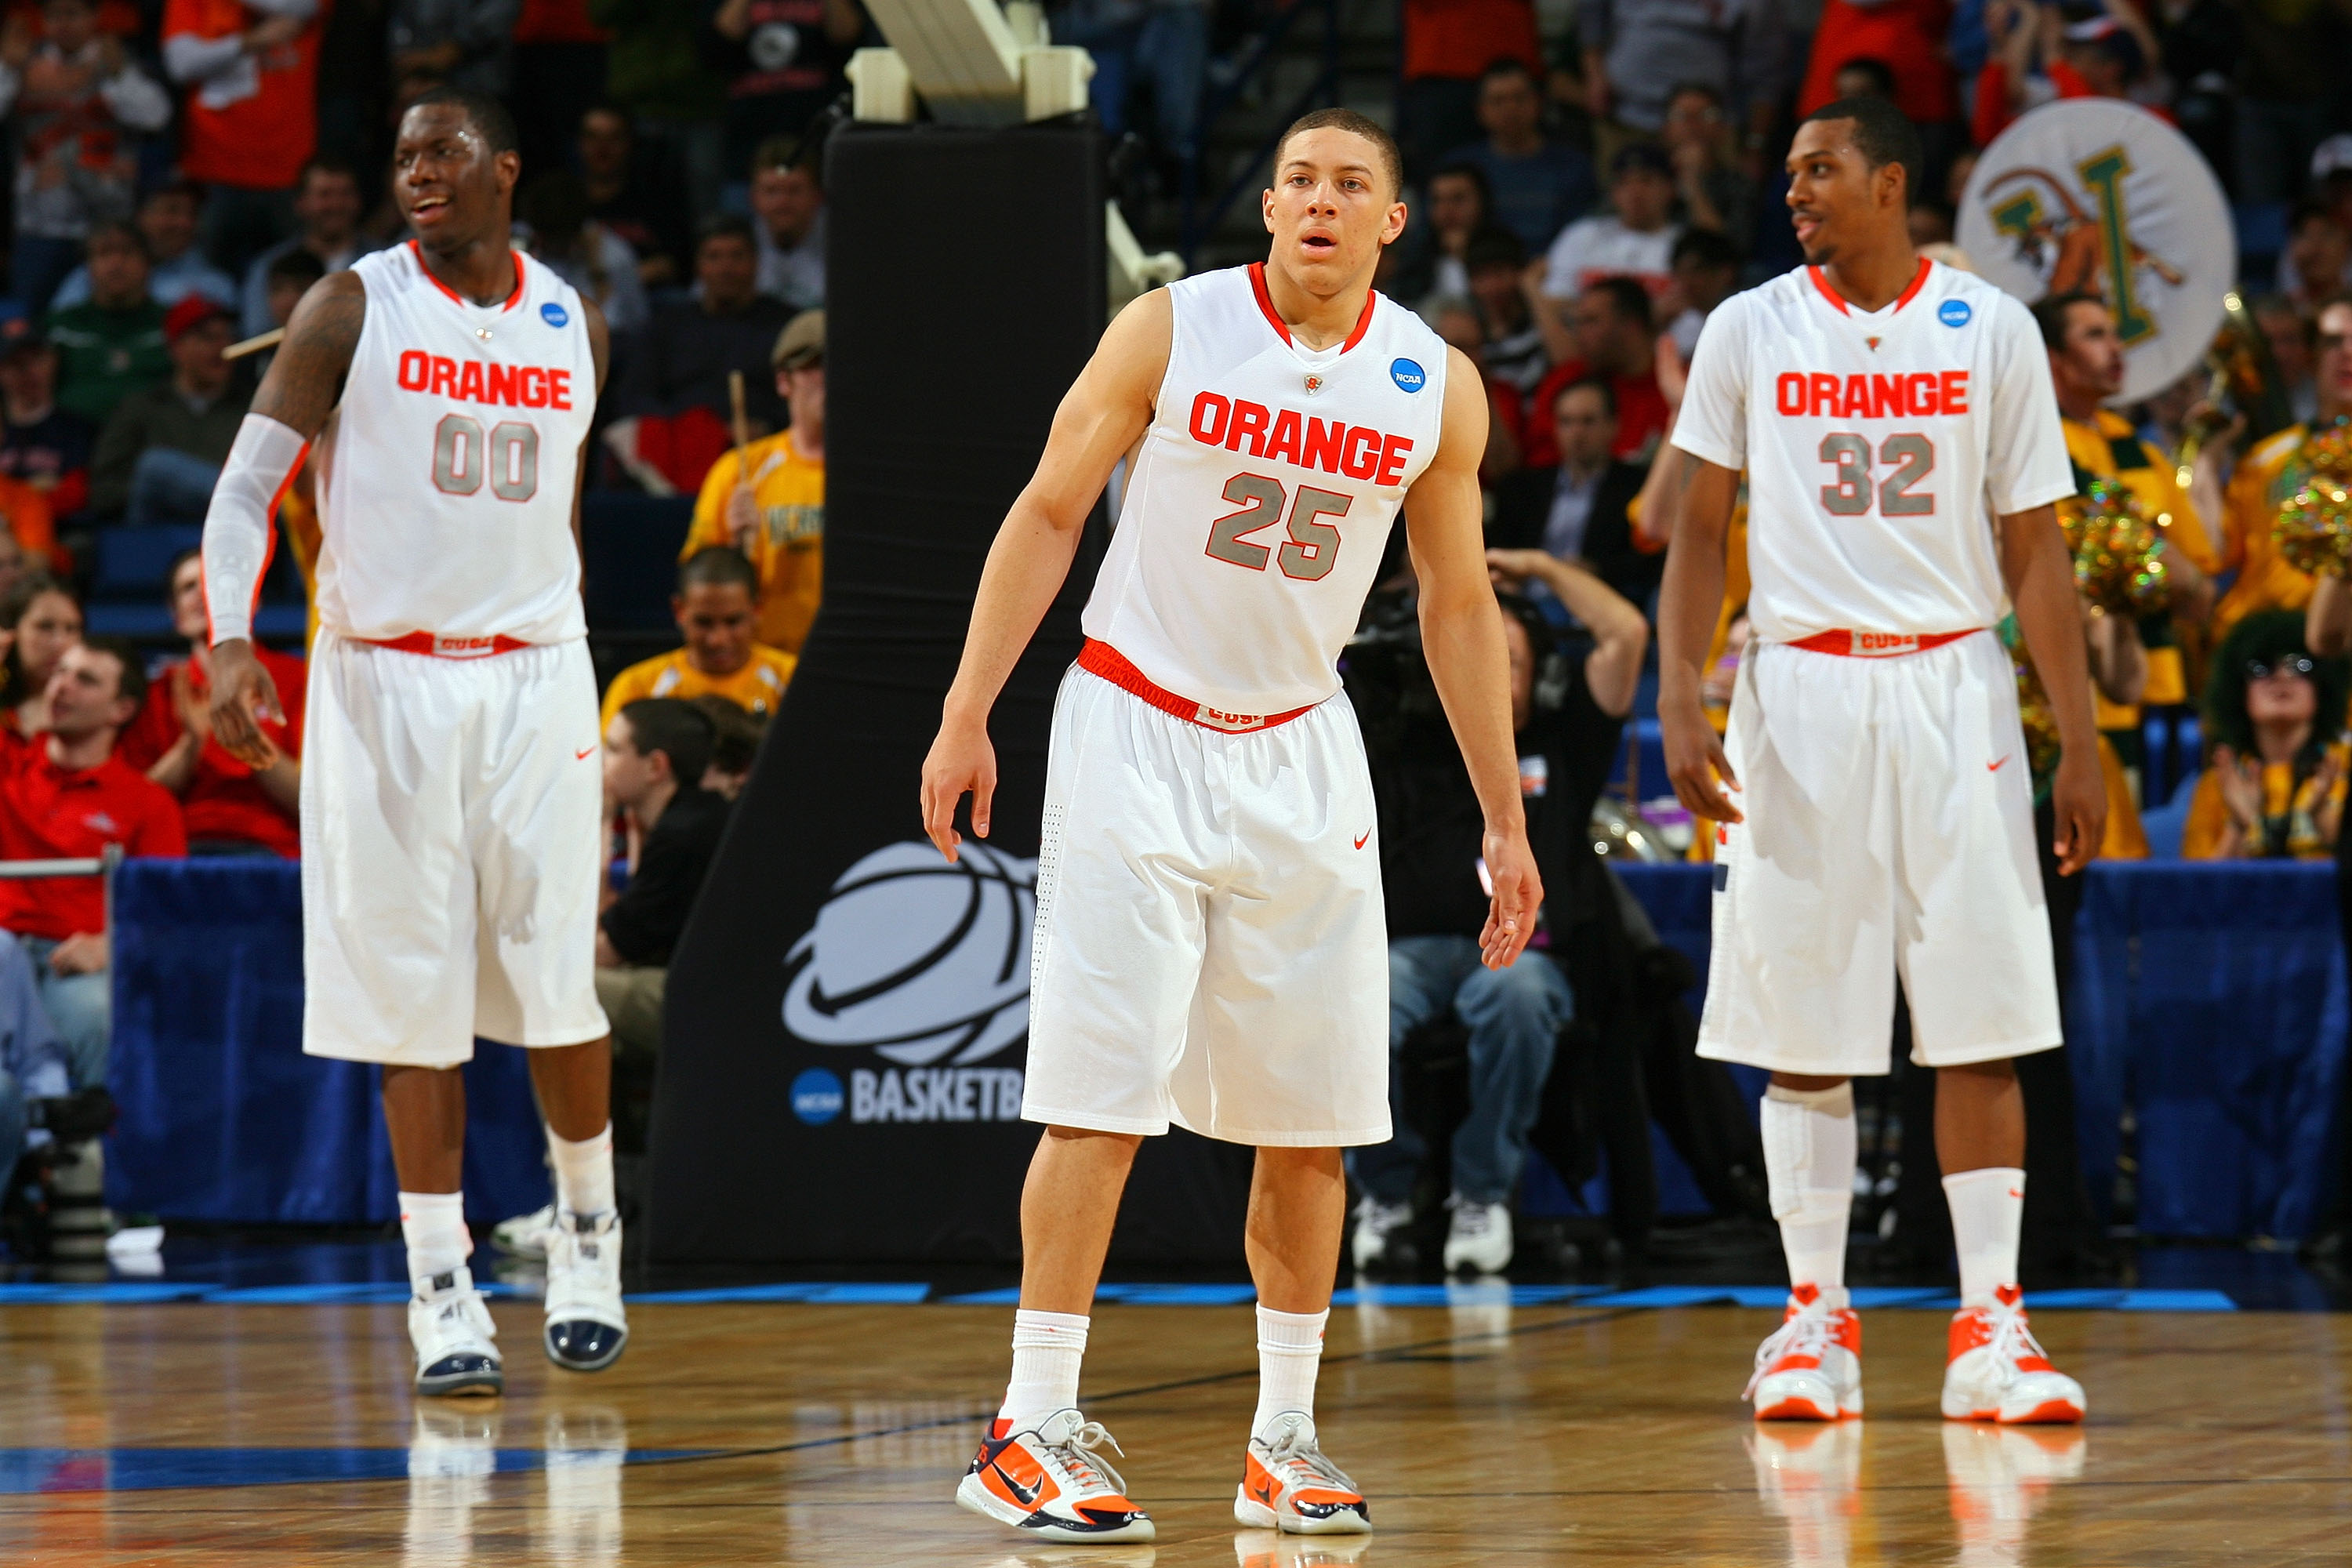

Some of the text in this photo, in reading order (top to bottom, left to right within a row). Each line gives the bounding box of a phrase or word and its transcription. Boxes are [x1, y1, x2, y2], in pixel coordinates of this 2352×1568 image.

[398, 350, 572, 411] ORANGE
[1395, 372, 1421, 384] NCAA
[1777, 370, 1969, 418] ORANGE
[432, 412, 539, 503] 00
[1189, 390, 1414, 486] ORANGE
[1820, 432, 1935, 517] 32
[1204, 471, 1354, 582] 25
[850, 1068, 1022, 1123] BASKETB
